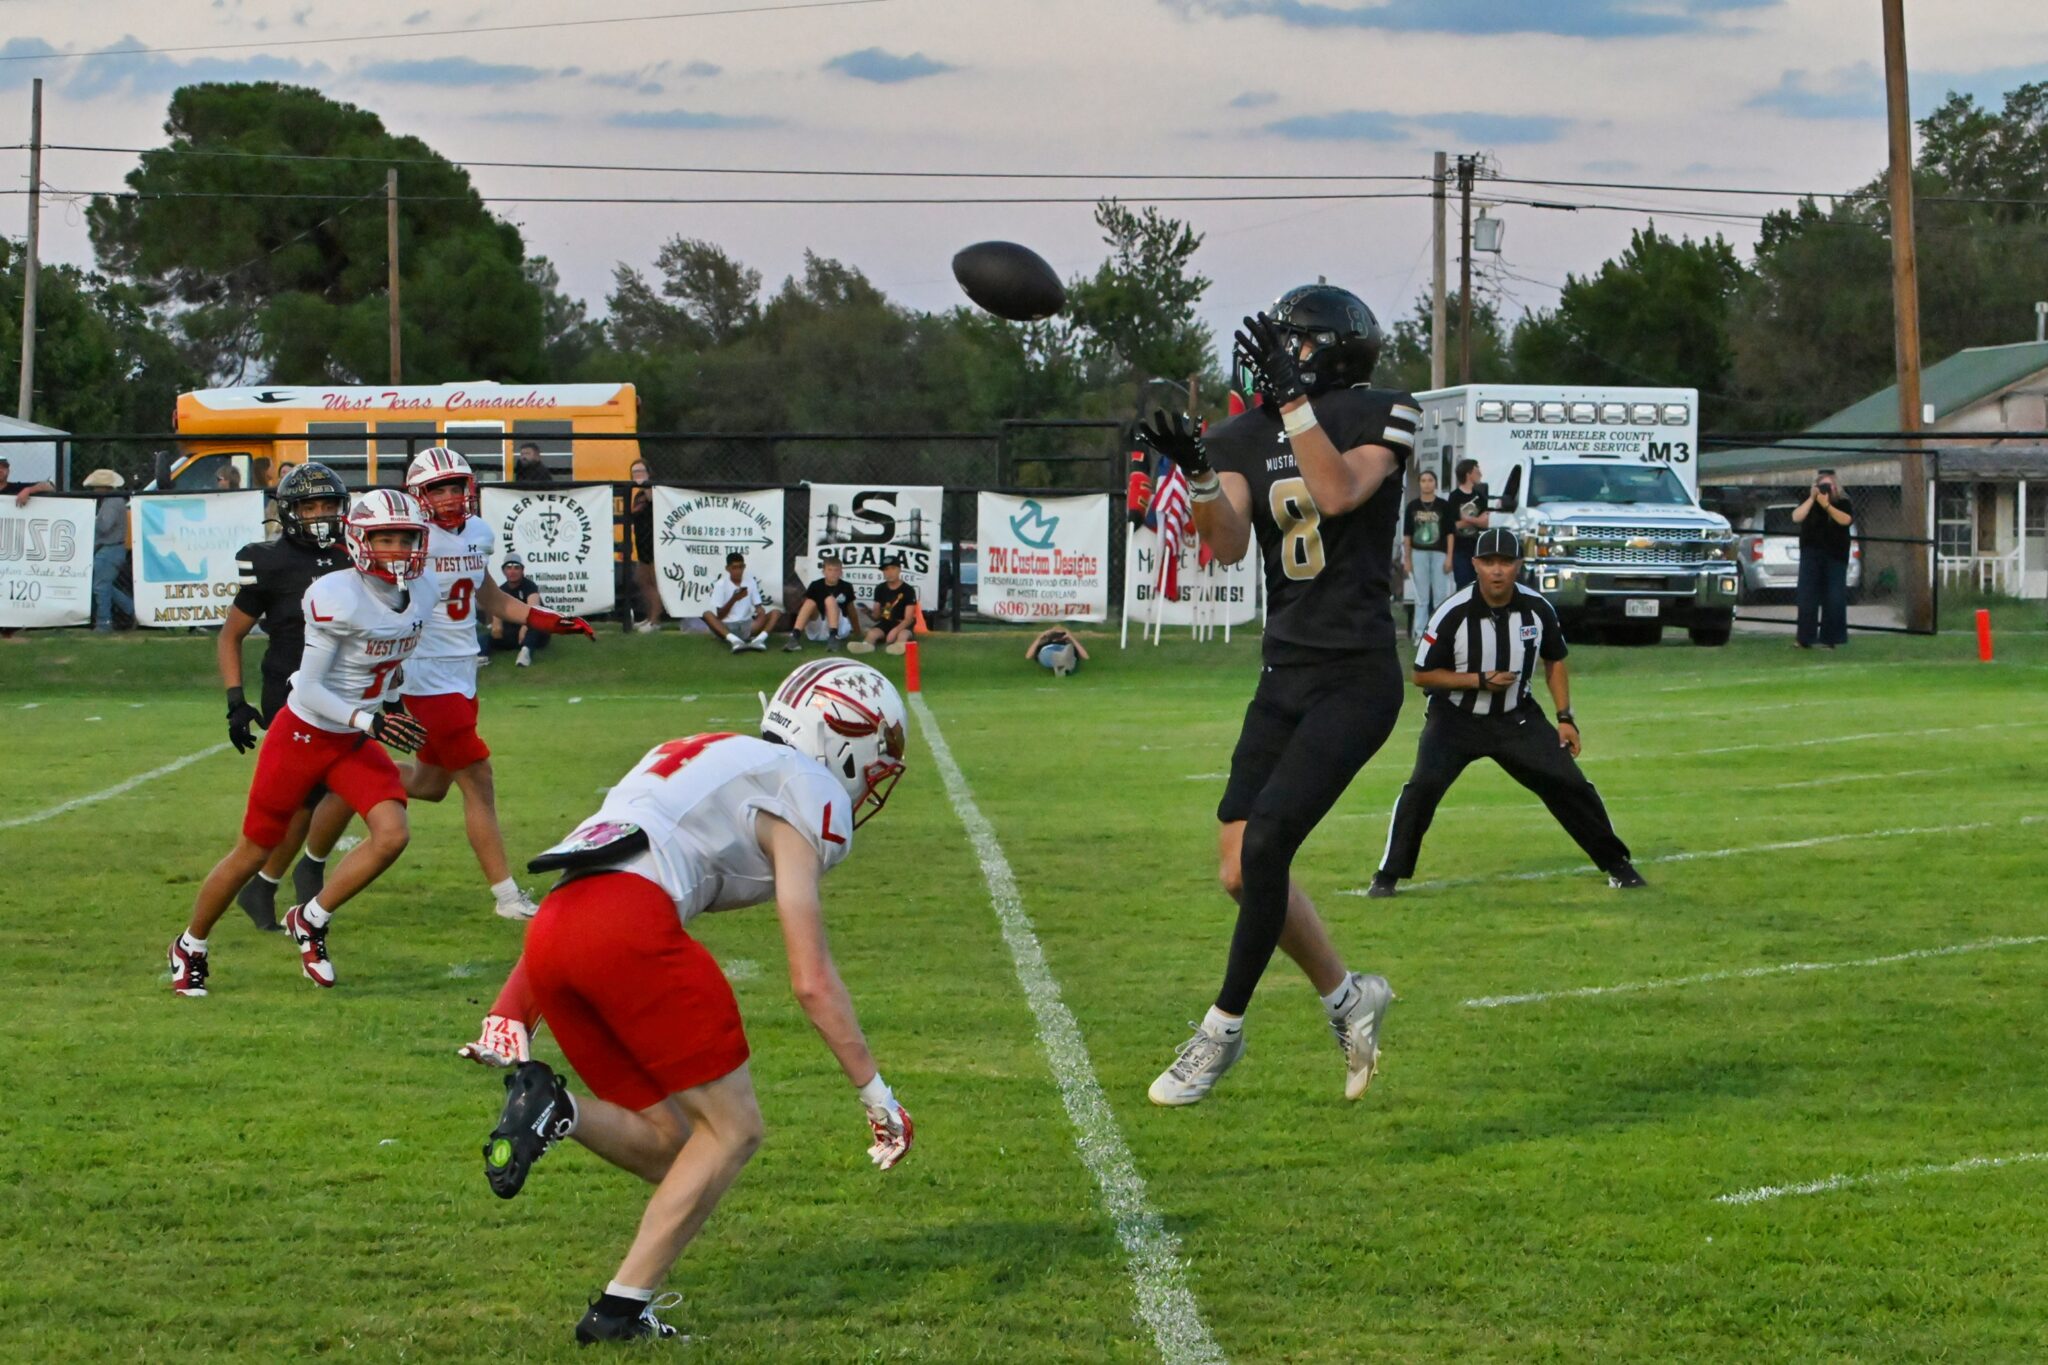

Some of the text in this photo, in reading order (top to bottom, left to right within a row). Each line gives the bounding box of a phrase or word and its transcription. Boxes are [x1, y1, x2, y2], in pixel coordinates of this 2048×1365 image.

[322, 390, 558, 413] West Texas Comanches
[1510, 430, 1655, 442] NORTH WHEELER COUNTY
[1522, 441, 1641, 452] AMBULANCE SERVICE
[1647, 442, 1690, 463] M3
[1266, 457, 1297, 471] MUSTA
[663, 501, 694, 530] ARROW
[694, 496, 729, 509] WATER
[731, 498, 757, 519] WELL
[851, 490, 899, 544] S
[503, 493, 592, 565] HEELER VETERINARY
[1269, 476, 1326, 580] 8
[527, 551, 570, 563] CLINIC
[725, 545, 750, 556] TEXAS
[435, 555, 483, 573] WEST TEXAS
[989, 546, 1097, 579] 7M Custom Designs
[535, 572, 567, 582] Hillhouse
[984, 576, 1099, 588] PERSONALIZED WOOD CREATIONS
[9, 580, 42, 602] 120
[164, 582, 242, 599] LET'S GO
[544, 595, 585, 604] Oklahoma
[1040, 590, 1078, 600] COPELAND
[993, 600, 1030, 617] (806)
[365, 638, 396, 656] WEST
[362, 659, 402, 699] 7
[767, 710, 792, 729] schutt
